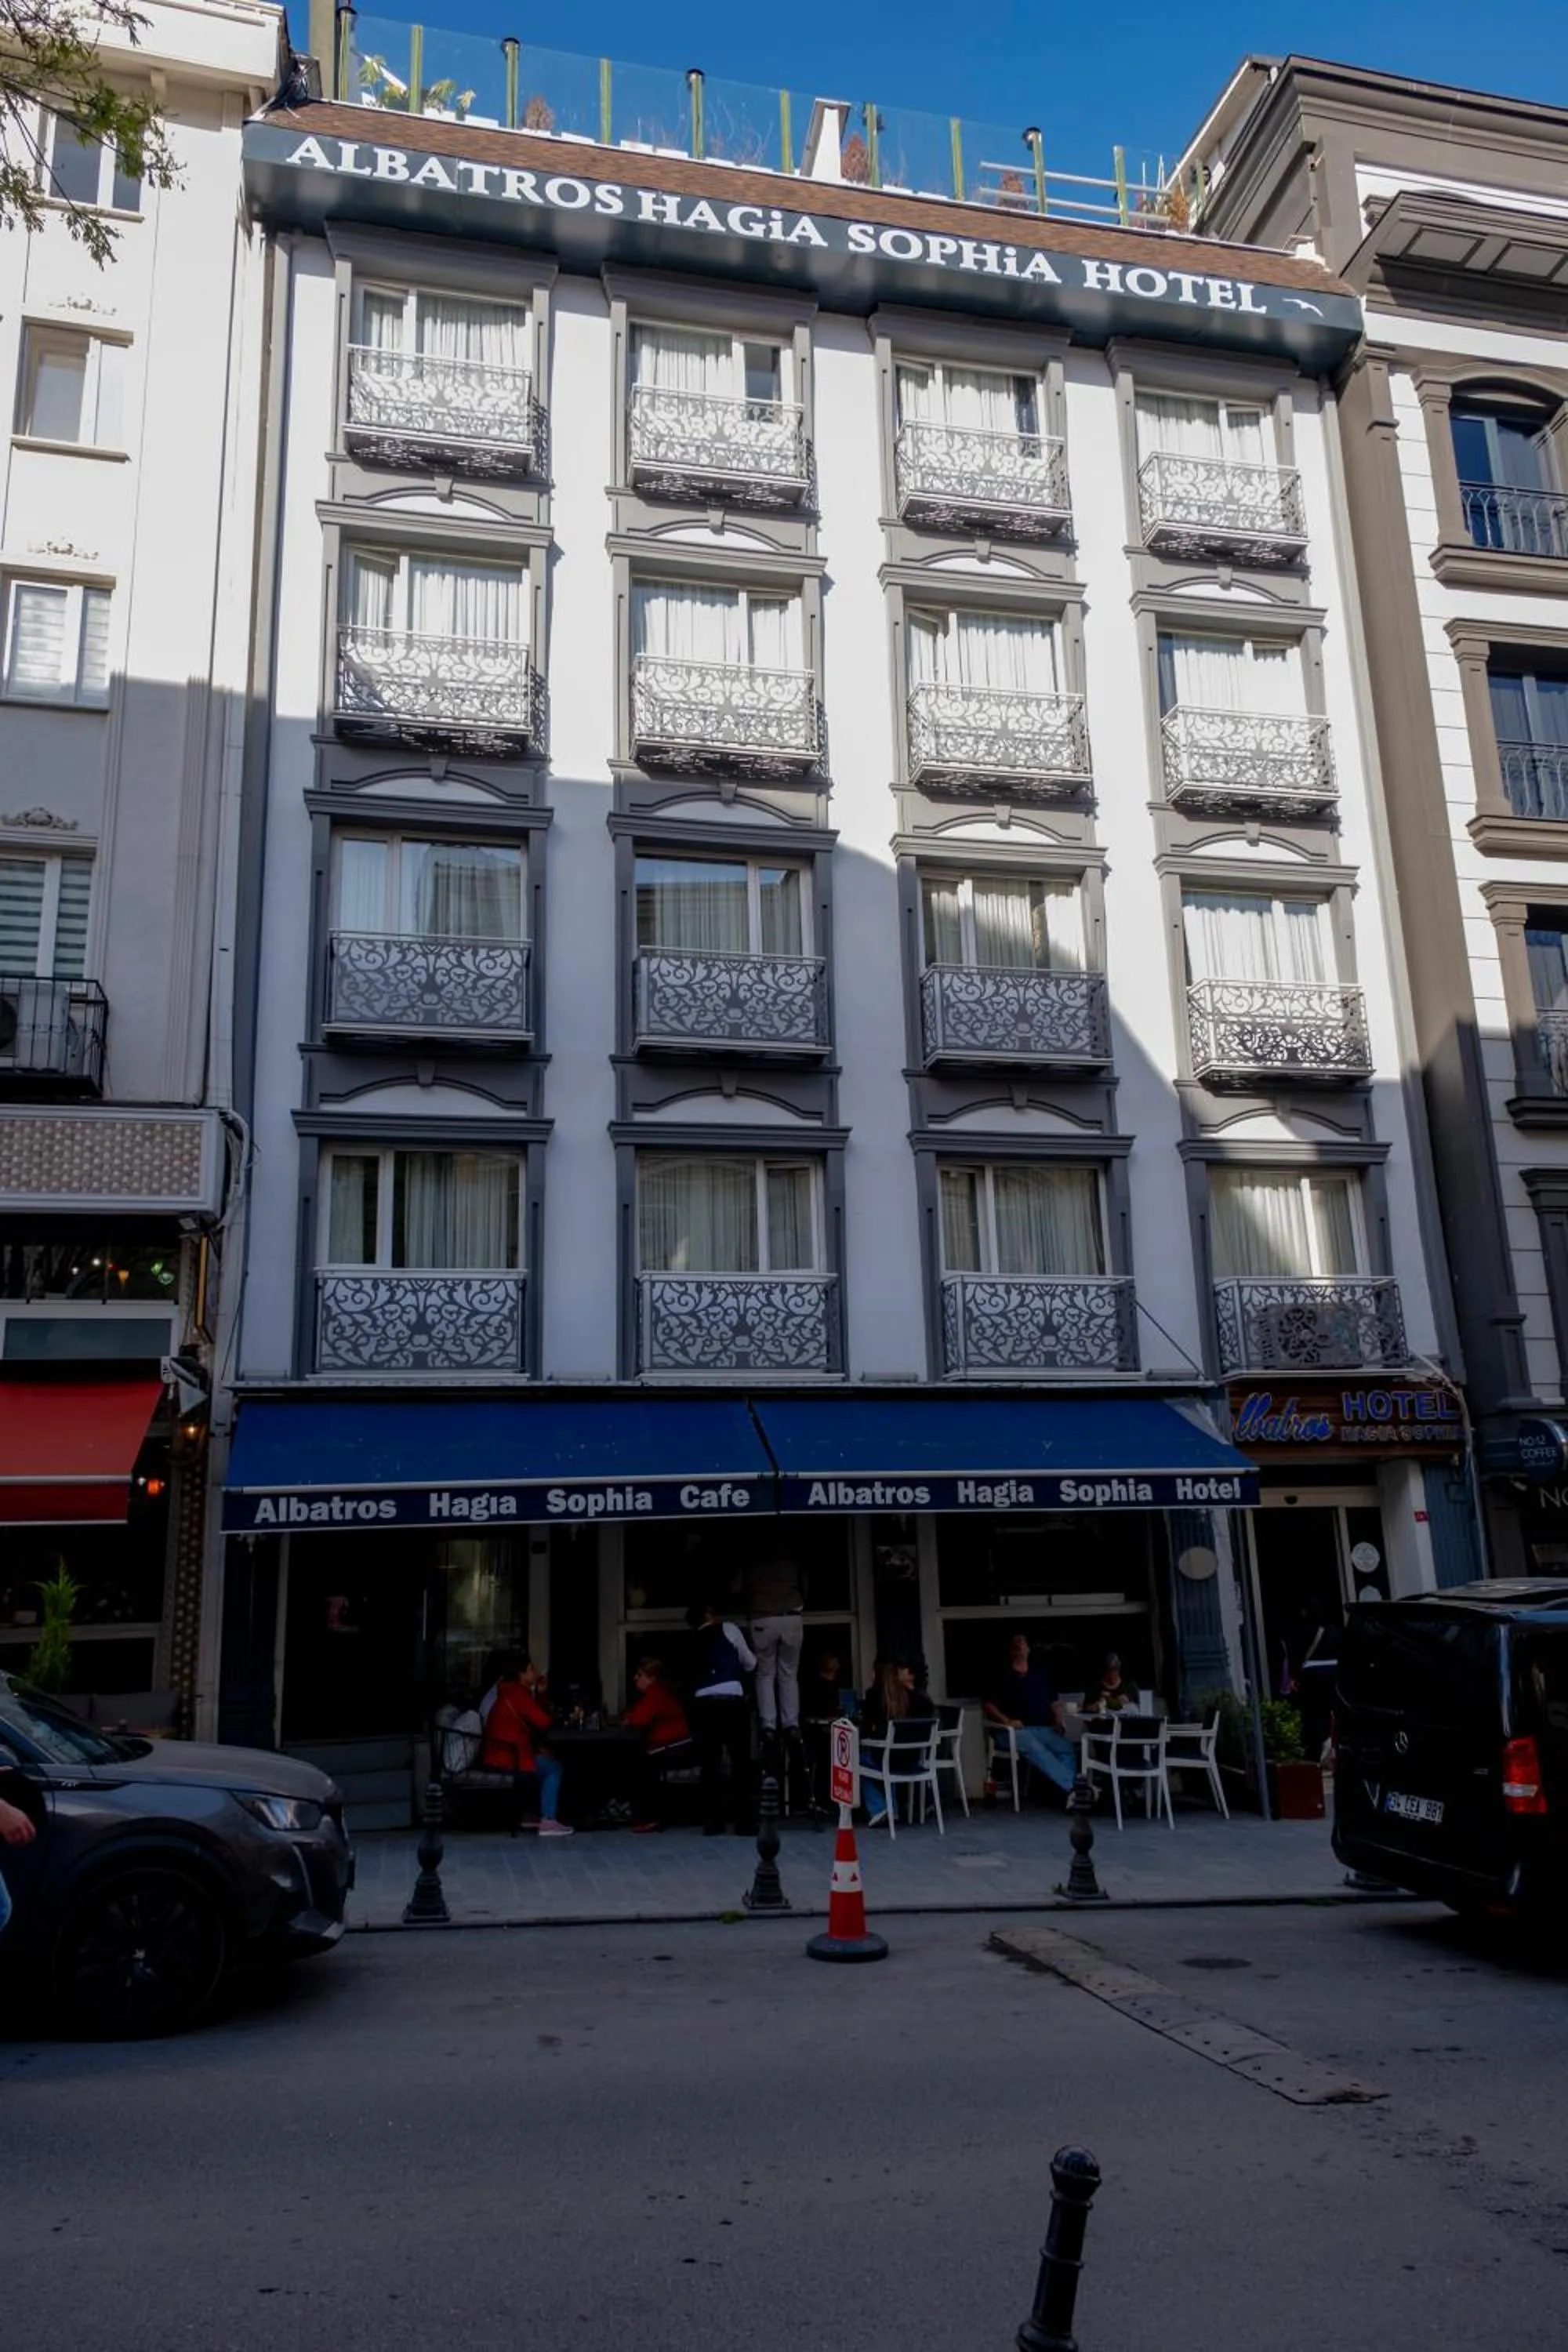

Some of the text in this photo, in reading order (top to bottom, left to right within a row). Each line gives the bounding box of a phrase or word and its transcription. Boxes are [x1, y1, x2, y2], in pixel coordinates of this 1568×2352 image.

[285, 136, 625, 215] ALBATROS
[1083, 260, 1266, 314] HOTEL
[1341, 1388, 1460, 1421] HOTEL
[254, 1497, 397, 1523] Albatros
[546, 1486, 654, 1517] Sophia
[679, 1483, 751, 1509] Cafe
[808, 1477, 1242, 1508] Albatros Hagia Sophia Hotel
